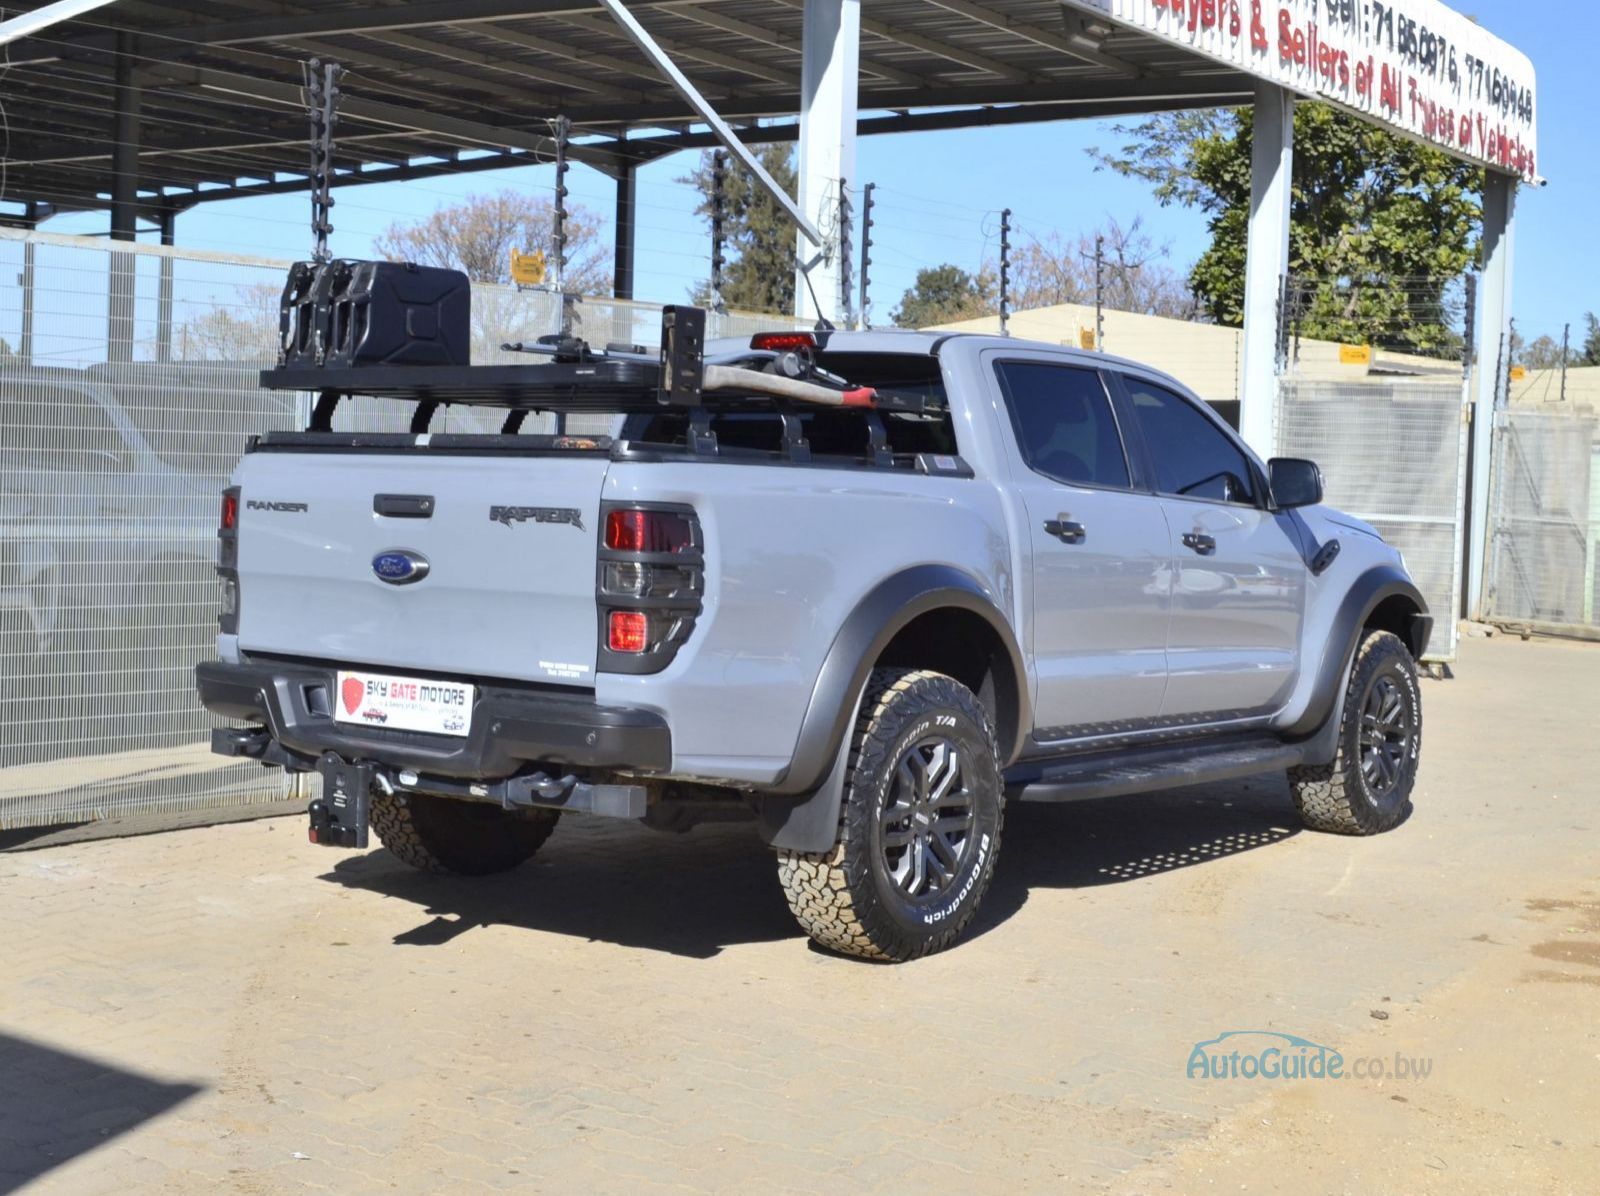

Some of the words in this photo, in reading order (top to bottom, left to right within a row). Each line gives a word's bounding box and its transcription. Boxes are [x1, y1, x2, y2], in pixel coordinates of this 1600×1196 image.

[1250, 0, 1268, 49] &
[1278, 9, 1349, 86] Sellers
[1380, 62, 1402, 120] All
[1477, 112, 1535, 176] Vehicles
[246, 500, 308, 512] RANGER
[489, 505, 586, 532] RAPTOR
[366, 681, 388, 696] SKY
[390, 683, 417, 700] GATE
[419, 686, 465, 705] MOTORS
[936, 715, 956, 728] T/A
[923, 833, 990, 925] BFGoodrich
